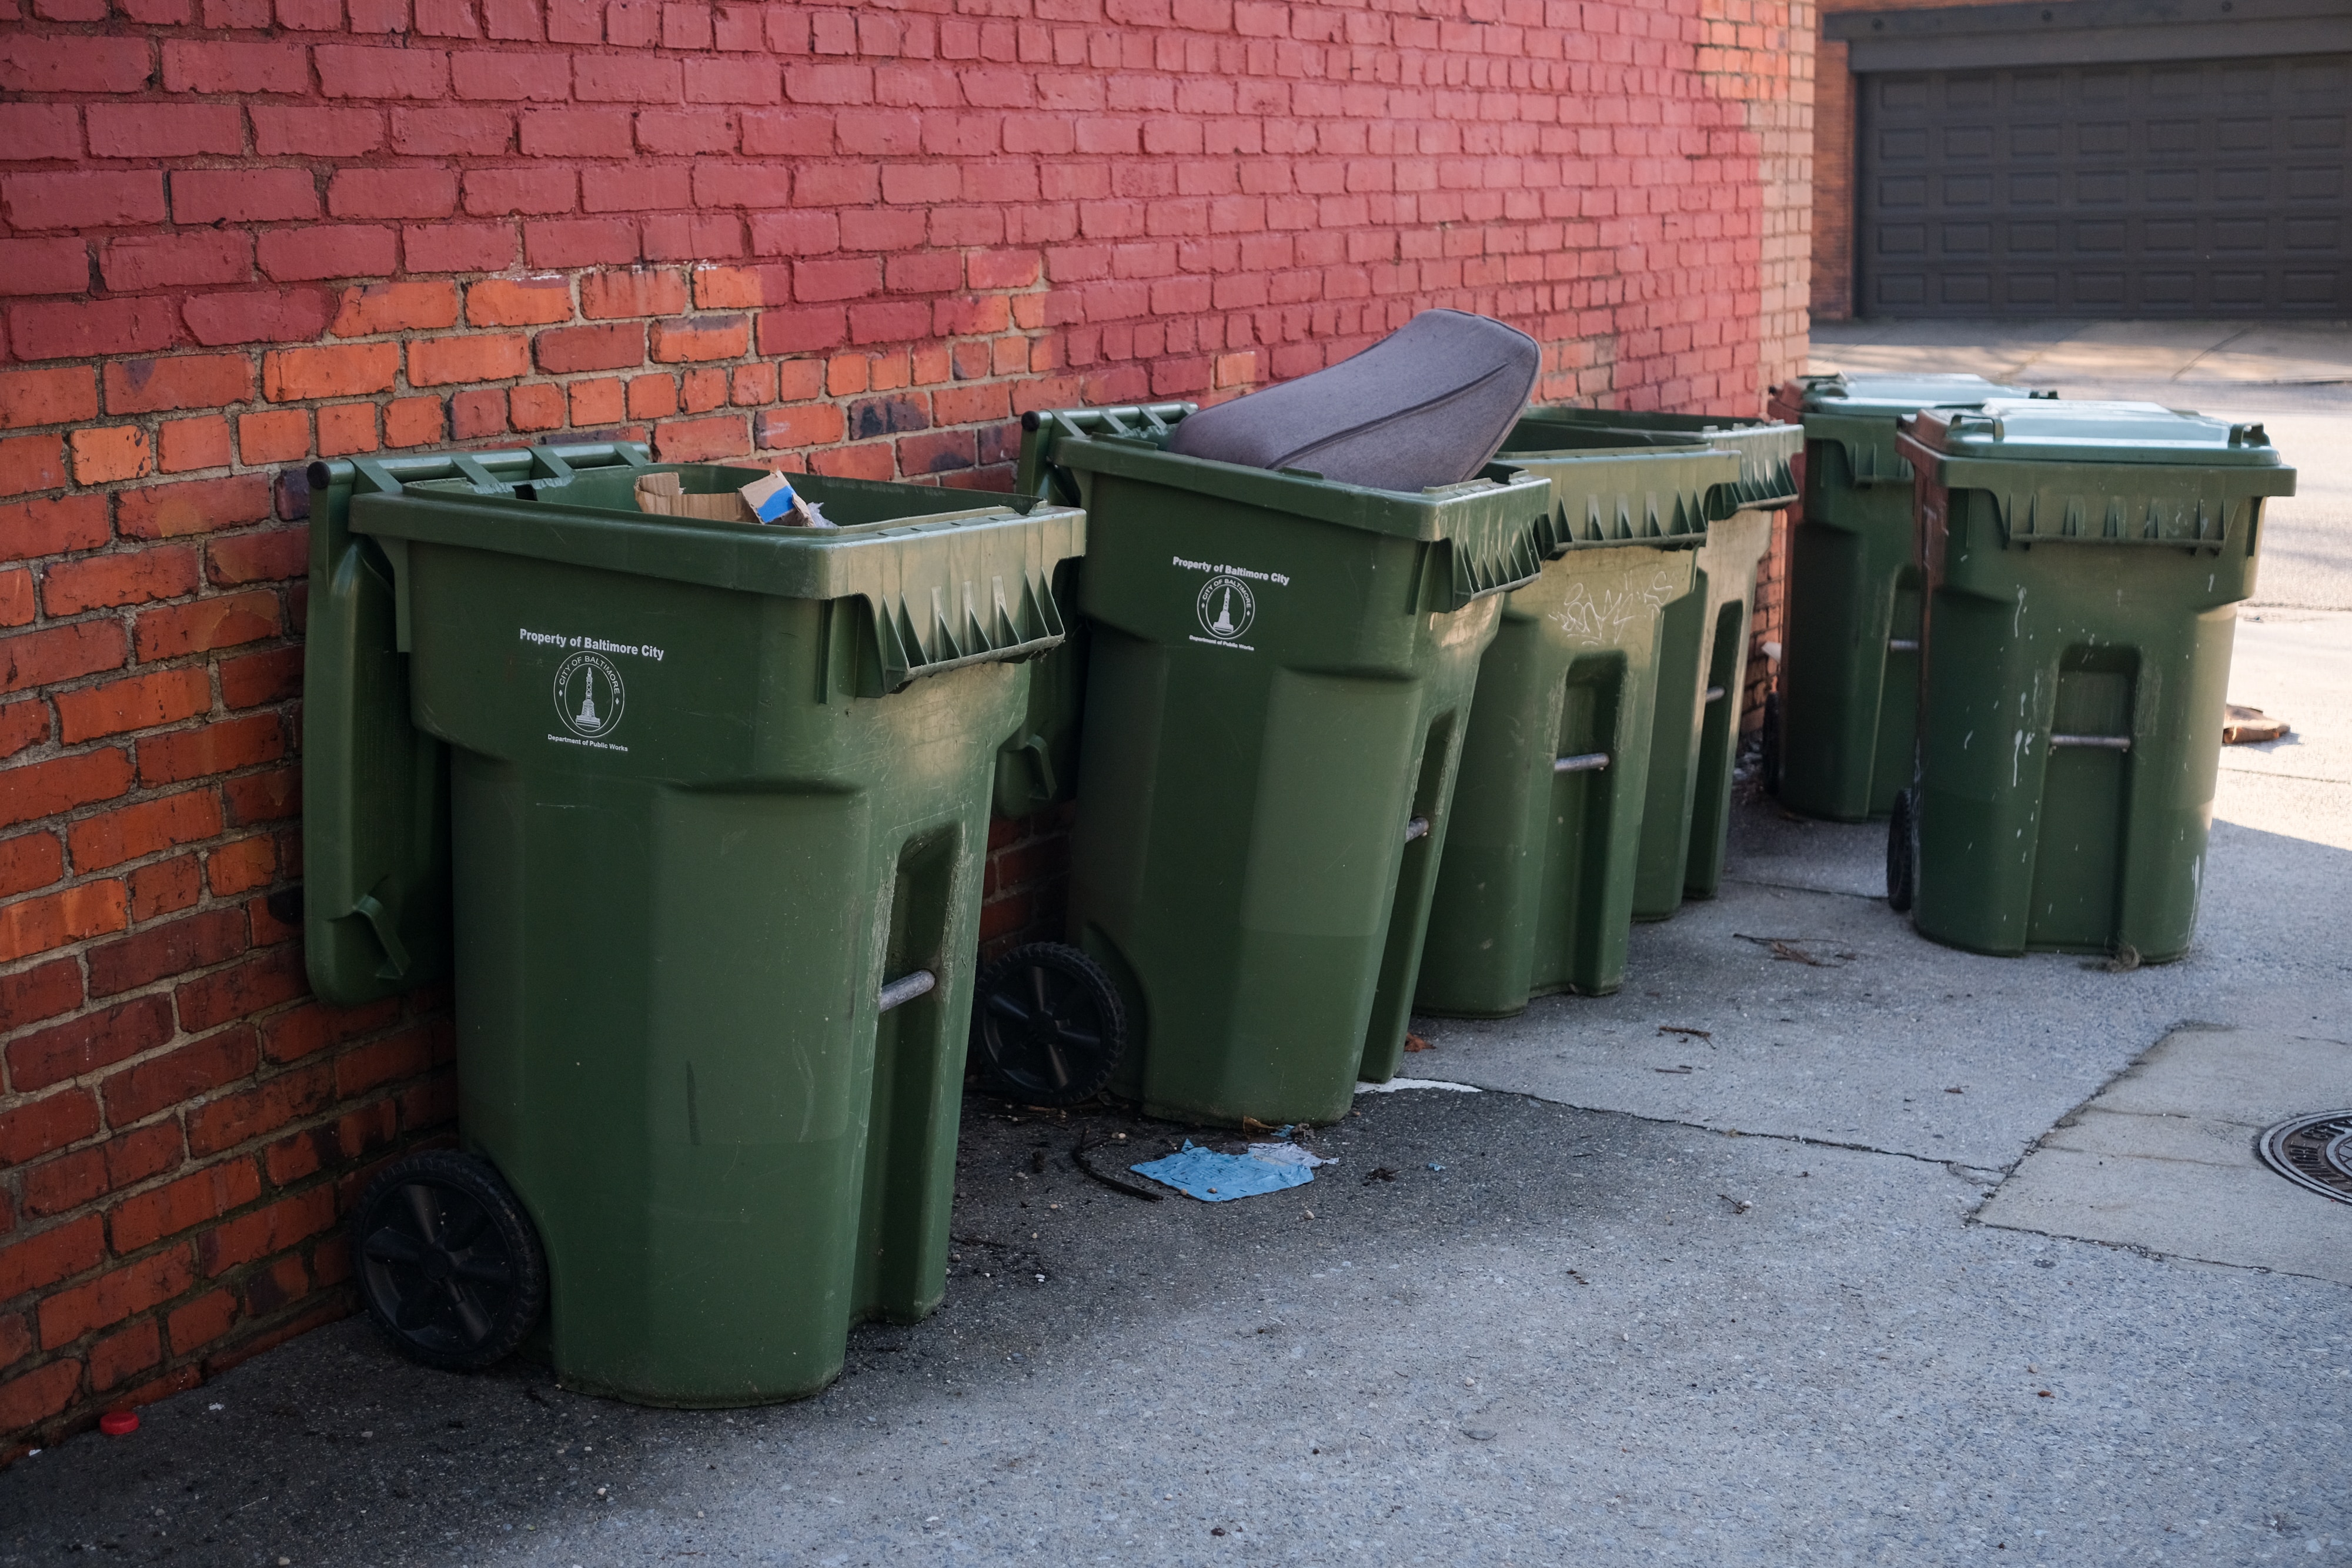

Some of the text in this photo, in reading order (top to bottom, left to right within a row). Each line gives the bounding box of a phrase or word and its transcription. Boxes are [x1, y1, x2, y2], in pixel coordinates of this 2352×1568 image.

[1172, 556, 1289, 586] Property of Baltimore City
[1202, 585, 1213, 600] CITY
[1225, 579, 1251, 608] BALTIMORE
[520, 628, 664, 661] Property of Baltimore City
[1189, 635, 1217, 644] Department
[559, 656, 620, 694] CITY OF BALTIMORE
[547, 734, 581, 745] Department
